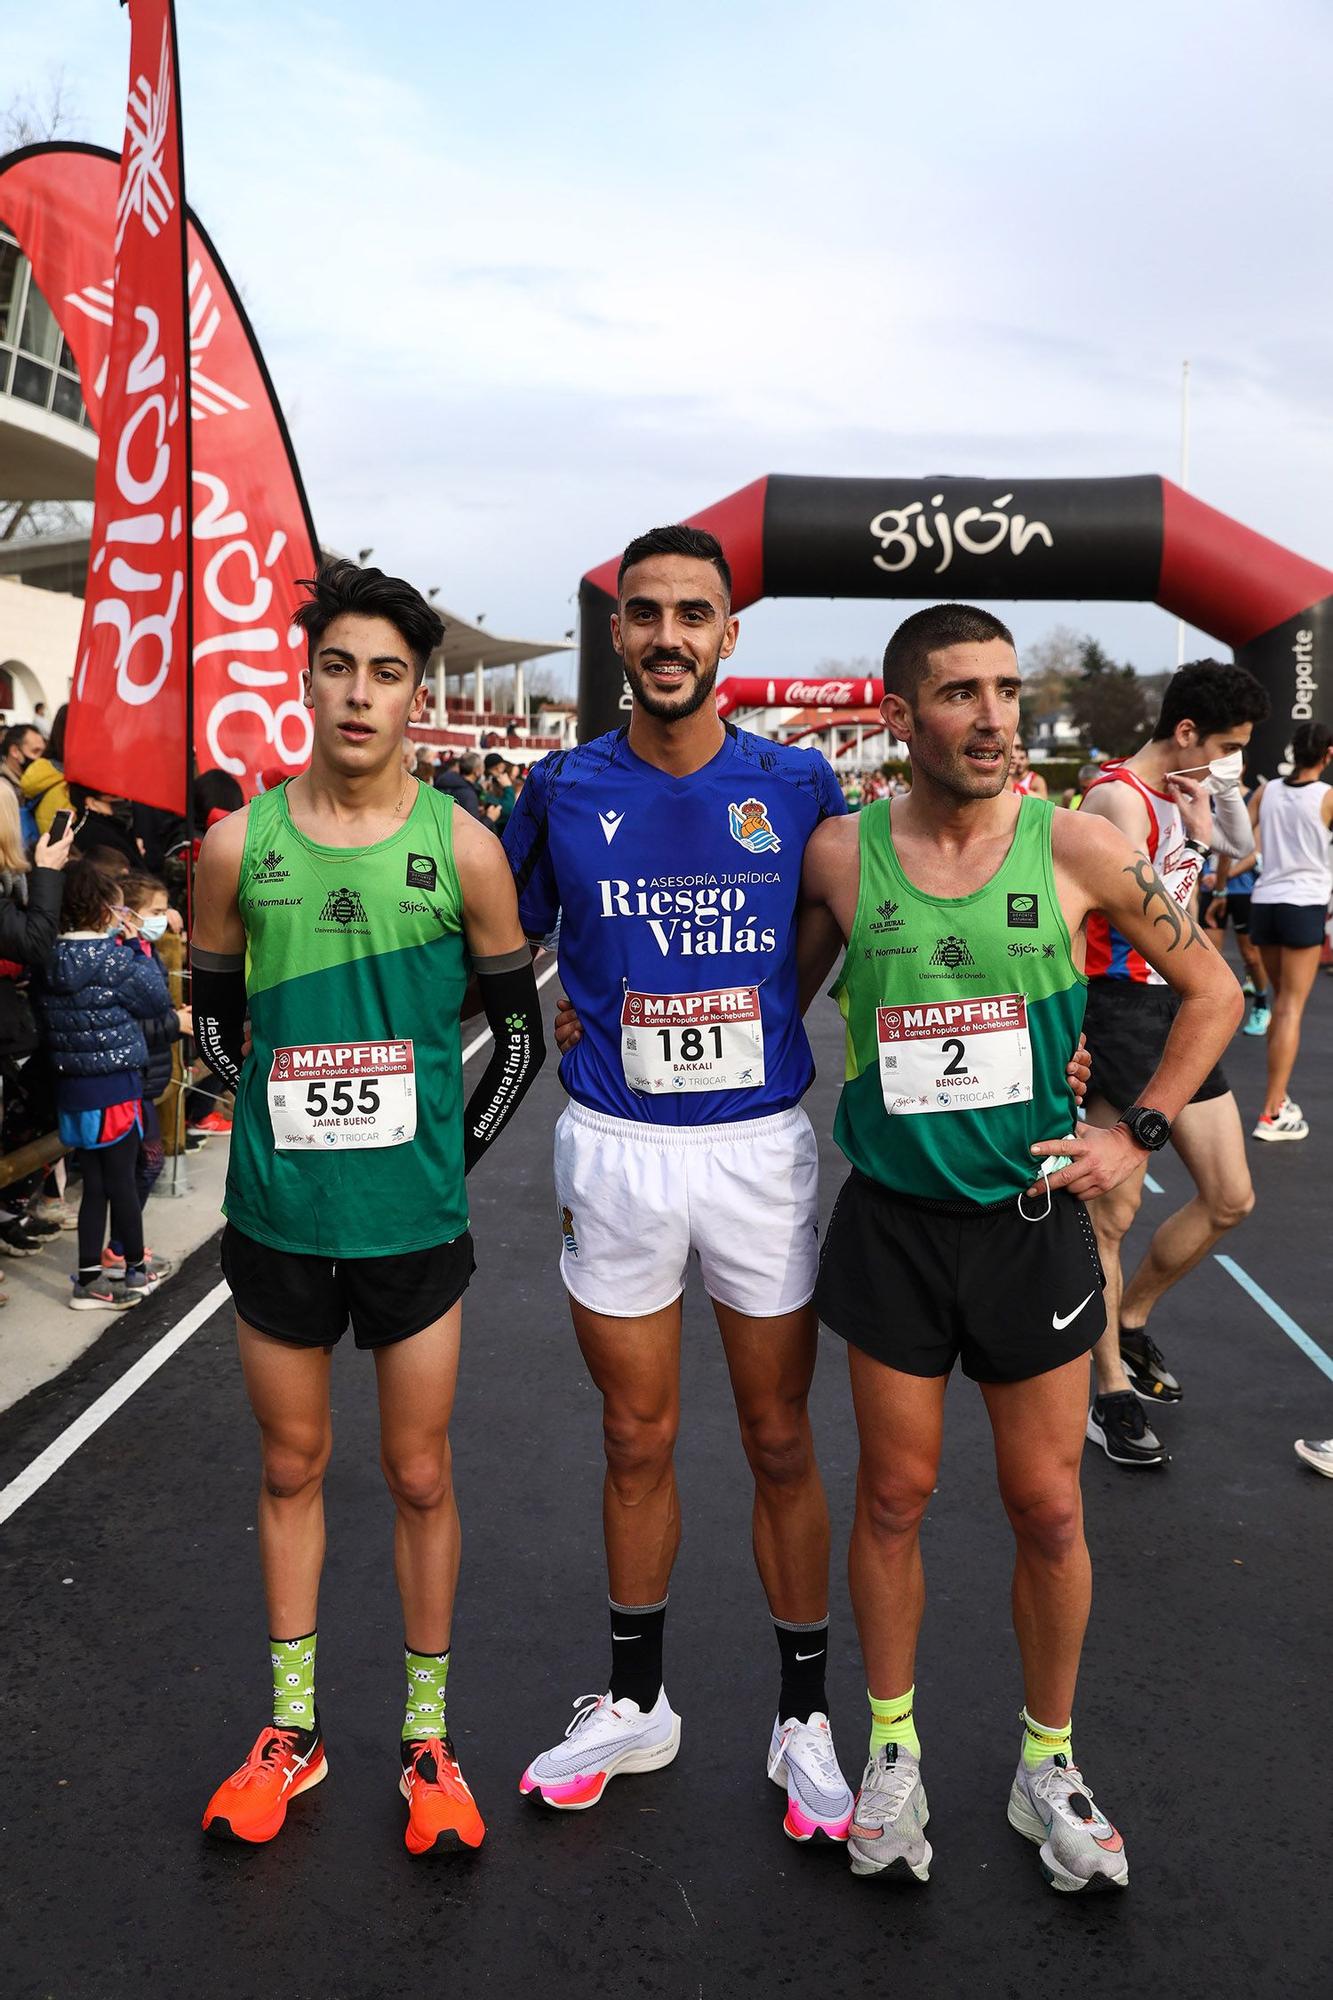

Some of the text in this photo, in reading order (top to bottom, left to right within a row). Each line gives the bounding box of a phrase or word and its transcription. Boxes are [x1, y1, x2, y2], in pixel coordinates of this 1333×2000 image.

[870, 493, 1054, 574] gijón
[1291, 629, 1319, 720] Deporte
[269, 870, 291, 878] RURAL
[650, 870, 781, 888] ASESORÍA JURÍDICA
[257, 897, 303, 907] NormaLux
[597, 877, 746, 927] Riesgo
[314, 926, 346, 934] Universidad
[353, 927, 371, 935] Oviedo
[884, 919, 906, 927] RURAL
[646, 915, 776, 957] Vialás
[875, 945, 919, 957] NormaLux
[919, 972, 955, 980] Universidad
[644, 990, 753, 1016] MAPFRE
[630, 1011, 754, 1025] 34 Carrera Popular de Nochebuena
[902, 999, 1018, 1028] MAPFRE
[888, 1030, 900, 1039] 34
[904, 1029, 931, 1037] Carrera
[932, 1027, 959, 1036] Popular
[973, 1019, 1019, 1031] Nochebuena
[199, 1016, 214, 1061] CARTUCHOS
[656, 1026, 723, 1062] 181
[292, 1044, 407, 1069] MAPFRE
[941, 1038, 968, 1076] 2
[278, 1064, 407, 1079] 34 Carrera Popular de Nochebuena
[673, 1062, 713, 1072] BAKKALI
[485, 1034, 530, 1141] CARTUCHOS PARA IMPRESORAS
[688, 1076, 728, 1086] TRIOCAR
[935, 1076, 979, 1088] BENGOA
[305, 1079, 381, 1117] 555
[954, 1091, 995, 1103] TRIOCAR
[312, 1116, 376, 1128] JAIME BUENO
[340, 1132, 379, 1142] TRIOCAR
